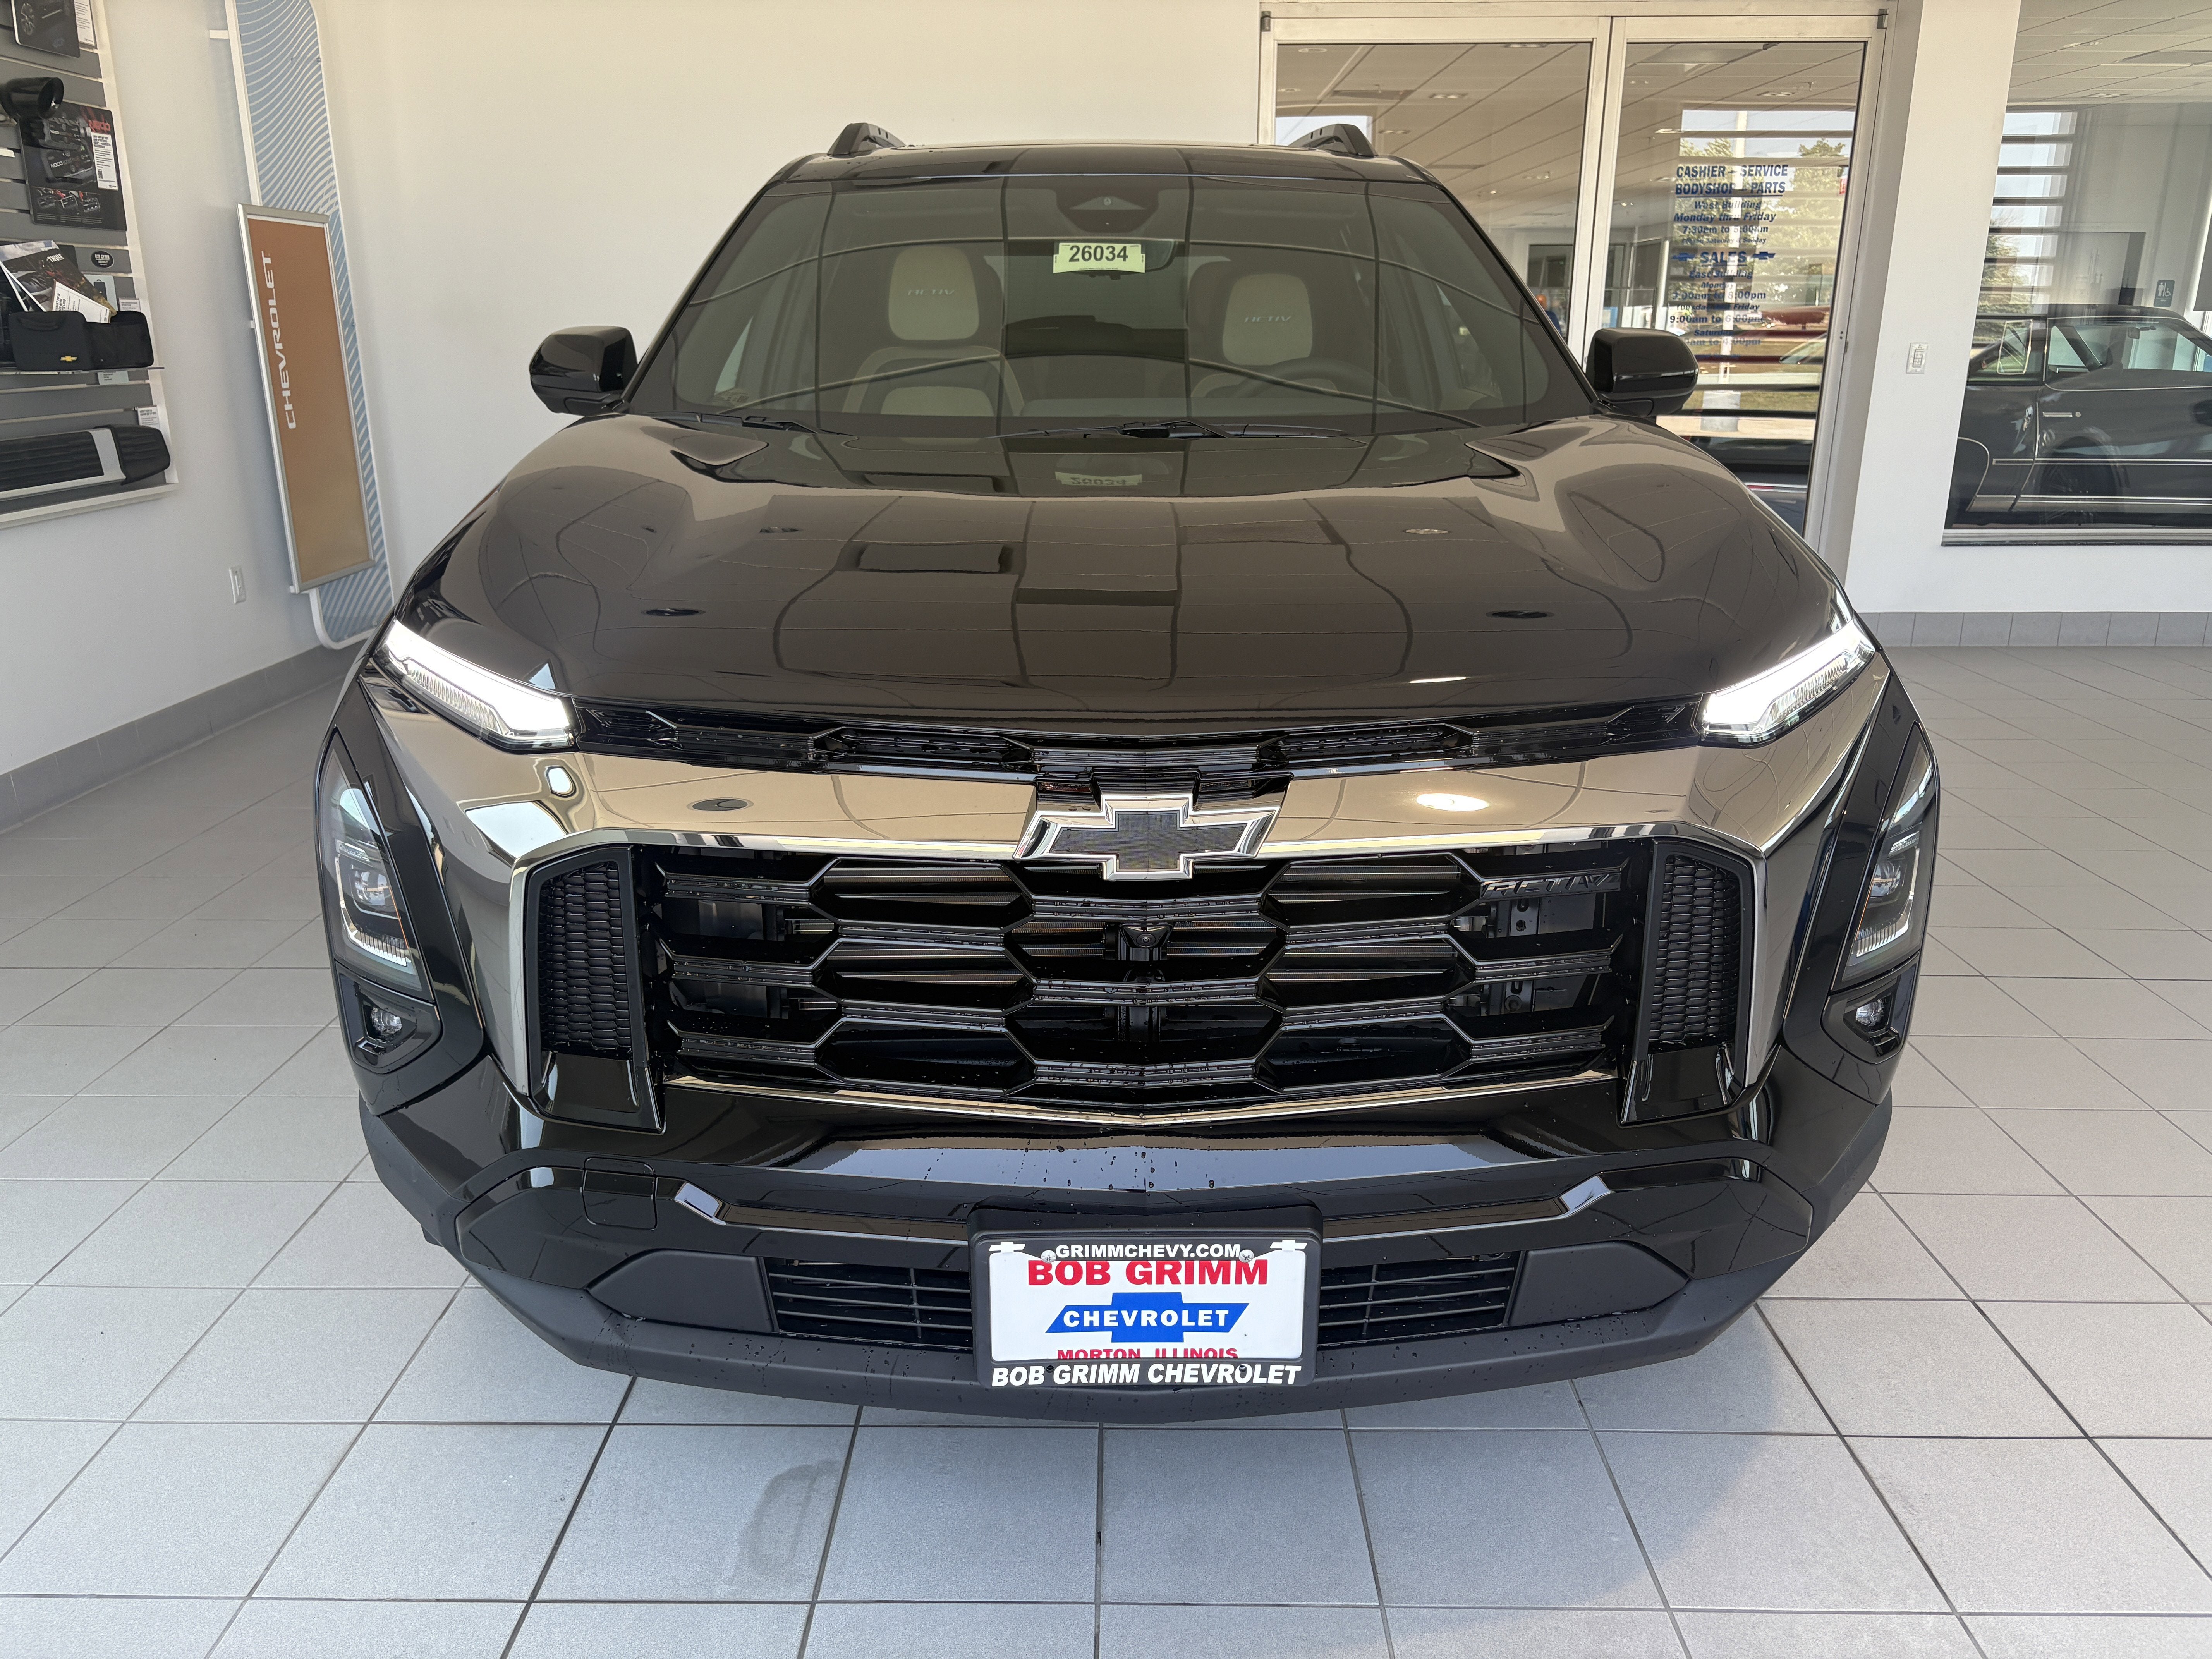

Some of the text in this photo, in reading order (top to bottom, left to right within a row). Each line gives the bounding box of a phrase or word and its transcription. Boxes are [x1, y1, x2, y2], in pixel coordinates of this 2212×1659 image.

[1676, 165, 1726, 178] CASHIER
[1740, 165, 1788, 177] SERVICE
[1675, 181, 1786, 195] BODYSHOP PARTS
[1674, 213, 1716, 223] Monday
[1743, 211, 1777, 222] Friday
[47, 254, 64, 262] THULE
[1069, 245, 1128, 262] 26034
[1700, 251, 1747, 263] SALES
[1728, 291, 1766, 300] 8:00pm
[1733, 302, 1760, 312] Friday
[261, 251, 296, 429] CHEVROLET
[1480, 874, 1610, 898] ACTIV
[1056, 1244, 1240, 1258] GRIMMCHEVY.COM
[1028, 1259, 1267, 1285] BOB GRIMM
[1063, 1310, 1229, 1327] CHEVROLET
[992, 1364, 1302, 1387] BOB GRIMM CHEVROLET
